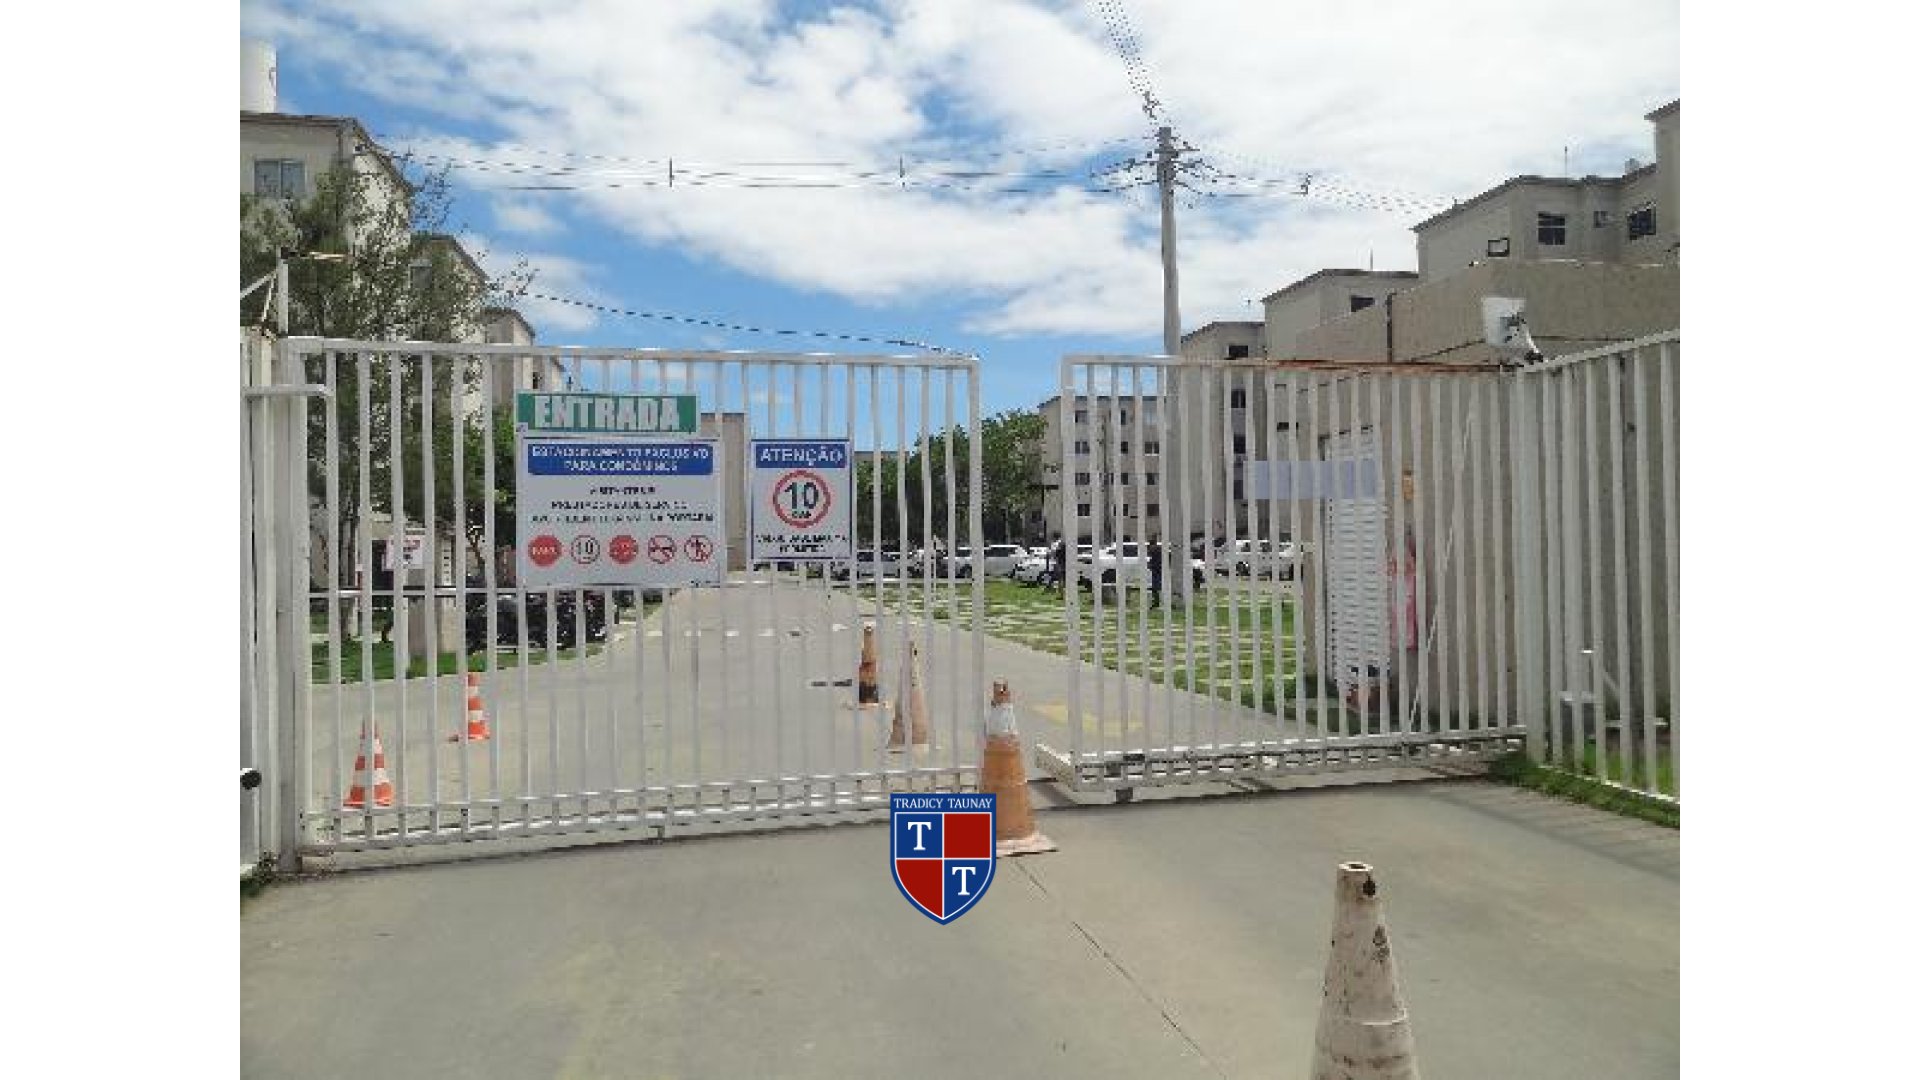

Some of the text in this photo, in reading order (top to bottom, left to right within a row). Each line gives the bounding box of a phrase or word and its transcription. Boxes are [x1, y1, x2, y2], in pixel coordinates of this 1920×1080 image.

[534, 395, 680, 430] ENTRADA
[760, 446, 843, 466] ATENÇÃO
[784, 482, 819, 509] 10
